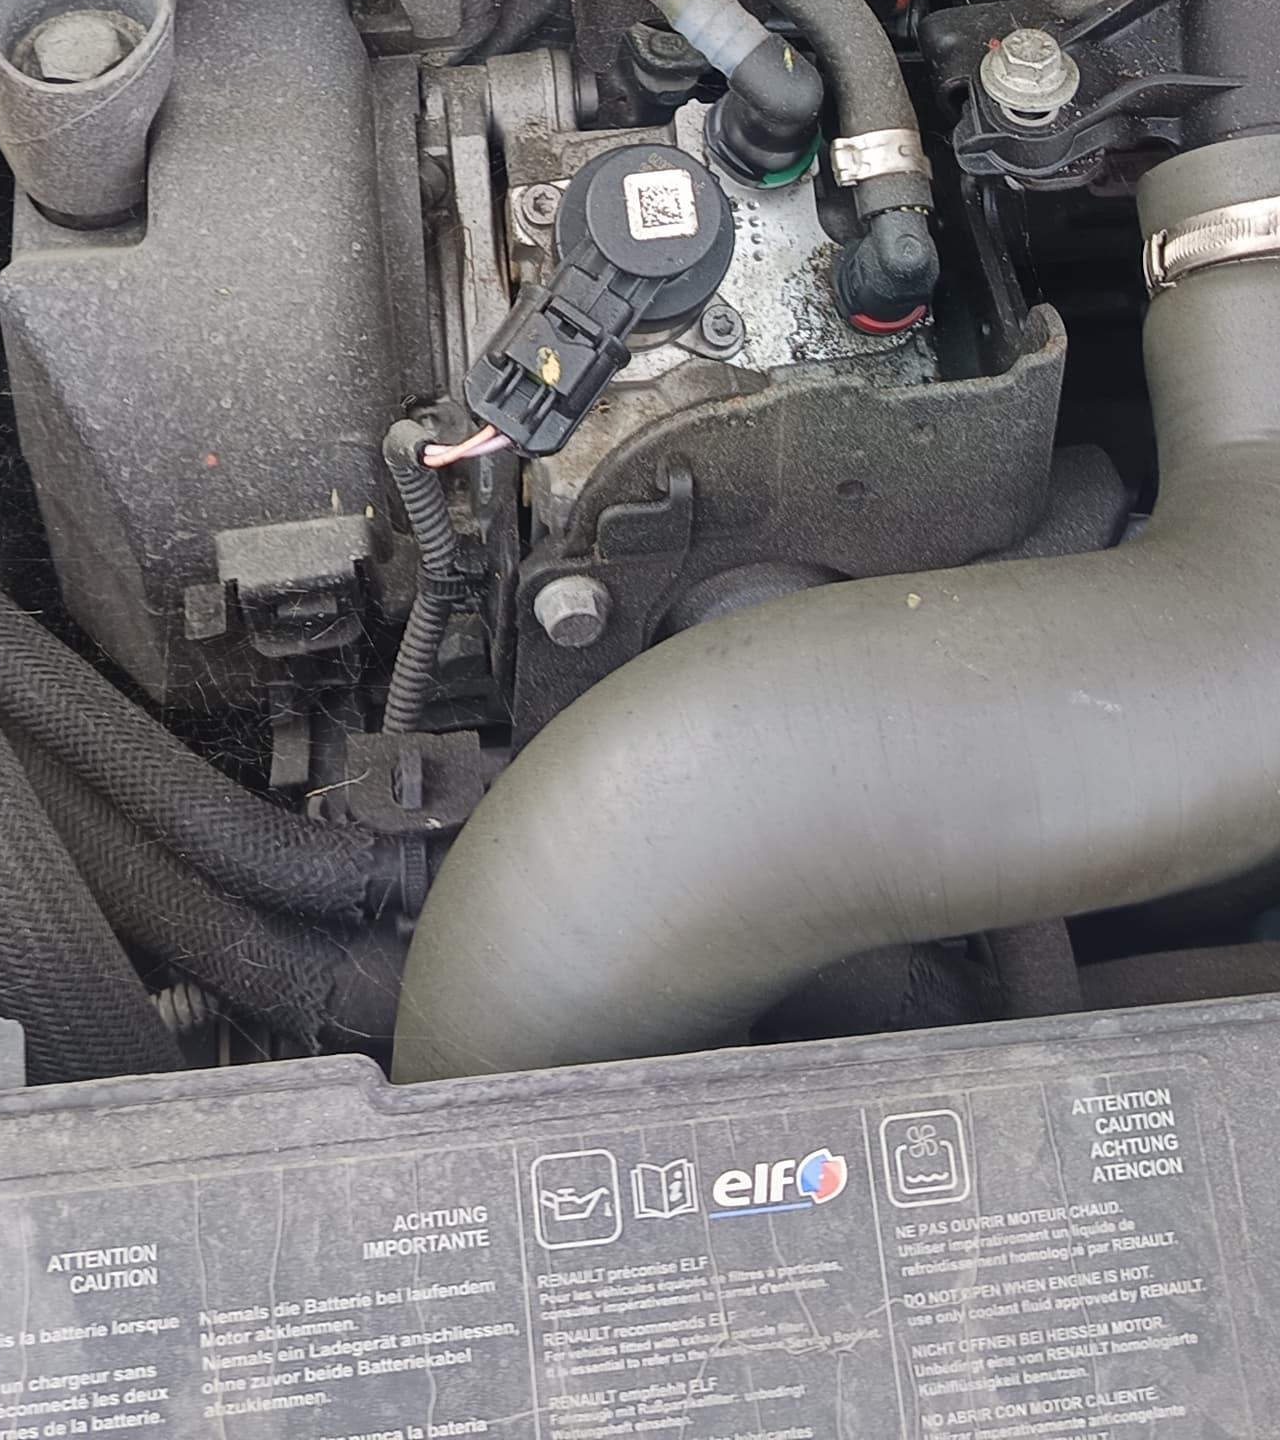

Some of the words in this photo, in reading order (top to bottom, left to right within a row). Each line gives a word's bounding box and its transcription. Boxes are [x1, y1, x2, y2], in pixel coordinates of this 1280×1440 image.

[1071, 1088, 1172, 1116] ATTENTION
[1095, 1110, 1176, 1135] CAUTION
[1090, 1133, 1180, 1160] ACHTUNG
[1091, 1157, 1184, 1184] ATENCION
[711, 1163, 799, 1207] elf
[391, 1204, 488, 1232] ACHTUNG
[894, 1224, 916, 1239] NE
[917, 1220, 948, 1236] PAS
[951, 1214, 1004, 1232] OUVRIR
[1006, 1206, 1067, 1226] MOTEUR
[1068, 1200, 1123, 1219] CHAUD.
[361, 1228, 490, 1260] IMPORTANTE
[1110, 1231, 1179, 1251] RENAULT.
[45, 1243, 158, 1272] ATTENTION
[68, 1267, 158, 1294] CAUTION
[536, 1267, 606, 1289] RENAULT
[679, 1256, 709, 1271] ELF
[1002, 1278, 1046, 1295] WHEN
[1047, 1271, 1102, 1290] ENGINE
[1103, 1269, 1118, 1283] IS
[1119, 1265, 1154, 1281] HOT.
[1138, 1278, 1207, 1298] RENAULT.
[198, 1304, 269, 1326] Niemals
[272, 1300, 300, 1317] die
[303, 1292, 372, 1314] Batterie
[375, 1289, 402, 1306] bei
[405, 1278, 496, 1302] laufendem
[18, 1329, 35, 1345] la
[39, 1321, 109, 1343] batterie
[110, 1313, 180, 1339] lorsque
[199, 1328, 253, 1348] Motor
[542, 1326, 612, 1346] RENAULT
[911, 1341, 957, 1358] NICHT
[1018, 1330, 1044, 1345] BEI
[1045, 1322, 1110, 1342] HEISSEM
[201, 1349, 273, 1371] Niemals
[276, 1345, 305, 1361] ein
[1045, 1341, 1110, 1361] RENAULT
[0, 1380, 23, 1394] un
[27, 1368, 111, 1395] chargeur
[112, 1364, 157, 1381] sans
[303, 1362, 353, 1382] beide
[689, 1376, 718, 1393] ELF
[91, 1389, 120, 1407] les
[122, 1384, 169, 1403] deux
[922, 1413, 944, 1428] NO
[994, 1402, 1028, 1419] CON
[1029, 1395, 1084, 1414] MOTOR
[42, 1419, 67, 1437] de
[68, 1417, 87, 1433] la
